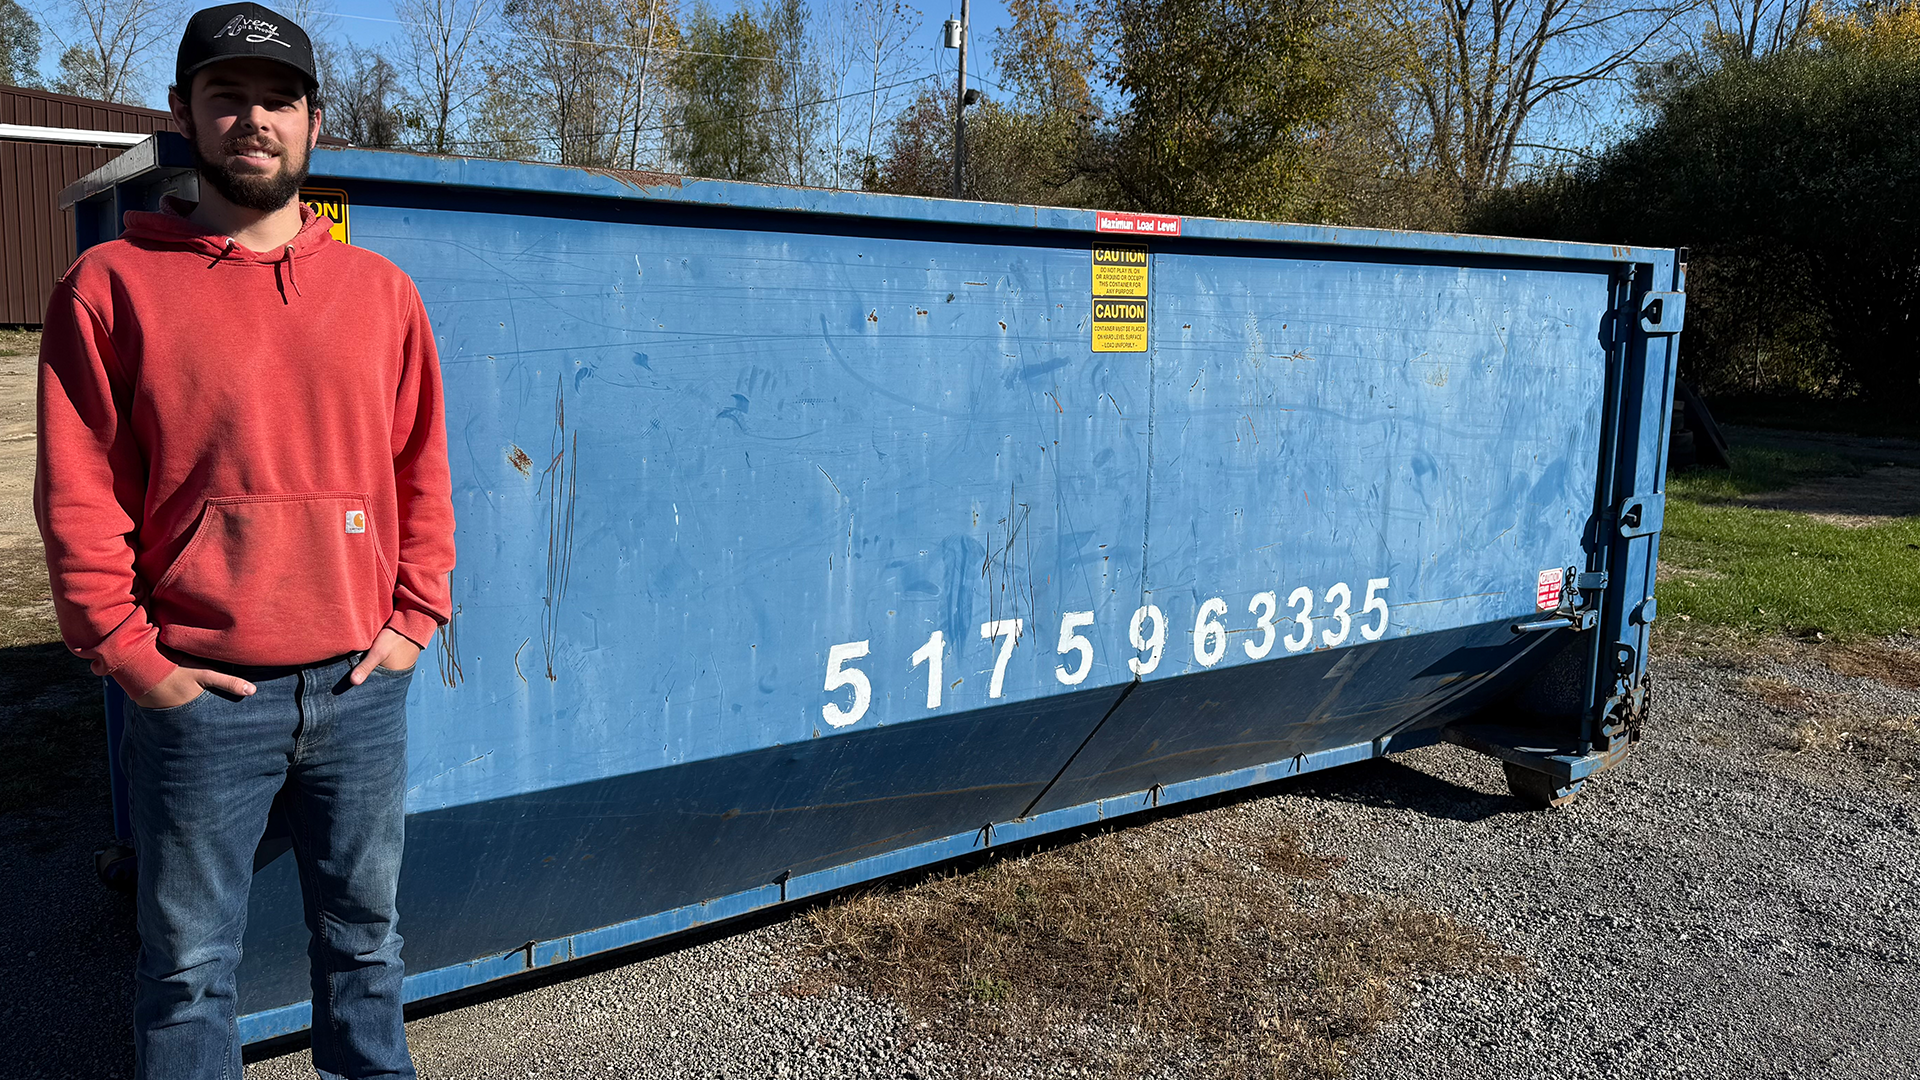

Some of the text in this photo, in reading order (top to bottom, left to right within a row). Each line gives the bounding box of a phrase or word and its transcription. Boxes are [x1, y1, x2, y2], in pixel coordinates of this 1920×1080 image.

[213, 14, 291, 48] Avery
[1137, 219, 1155, 231] Load
[1157, 220, 1177, 232] Level
[1095, 248, 1146, 263] CAUTION
[1095, 303, 1145, 319] CAUTION
